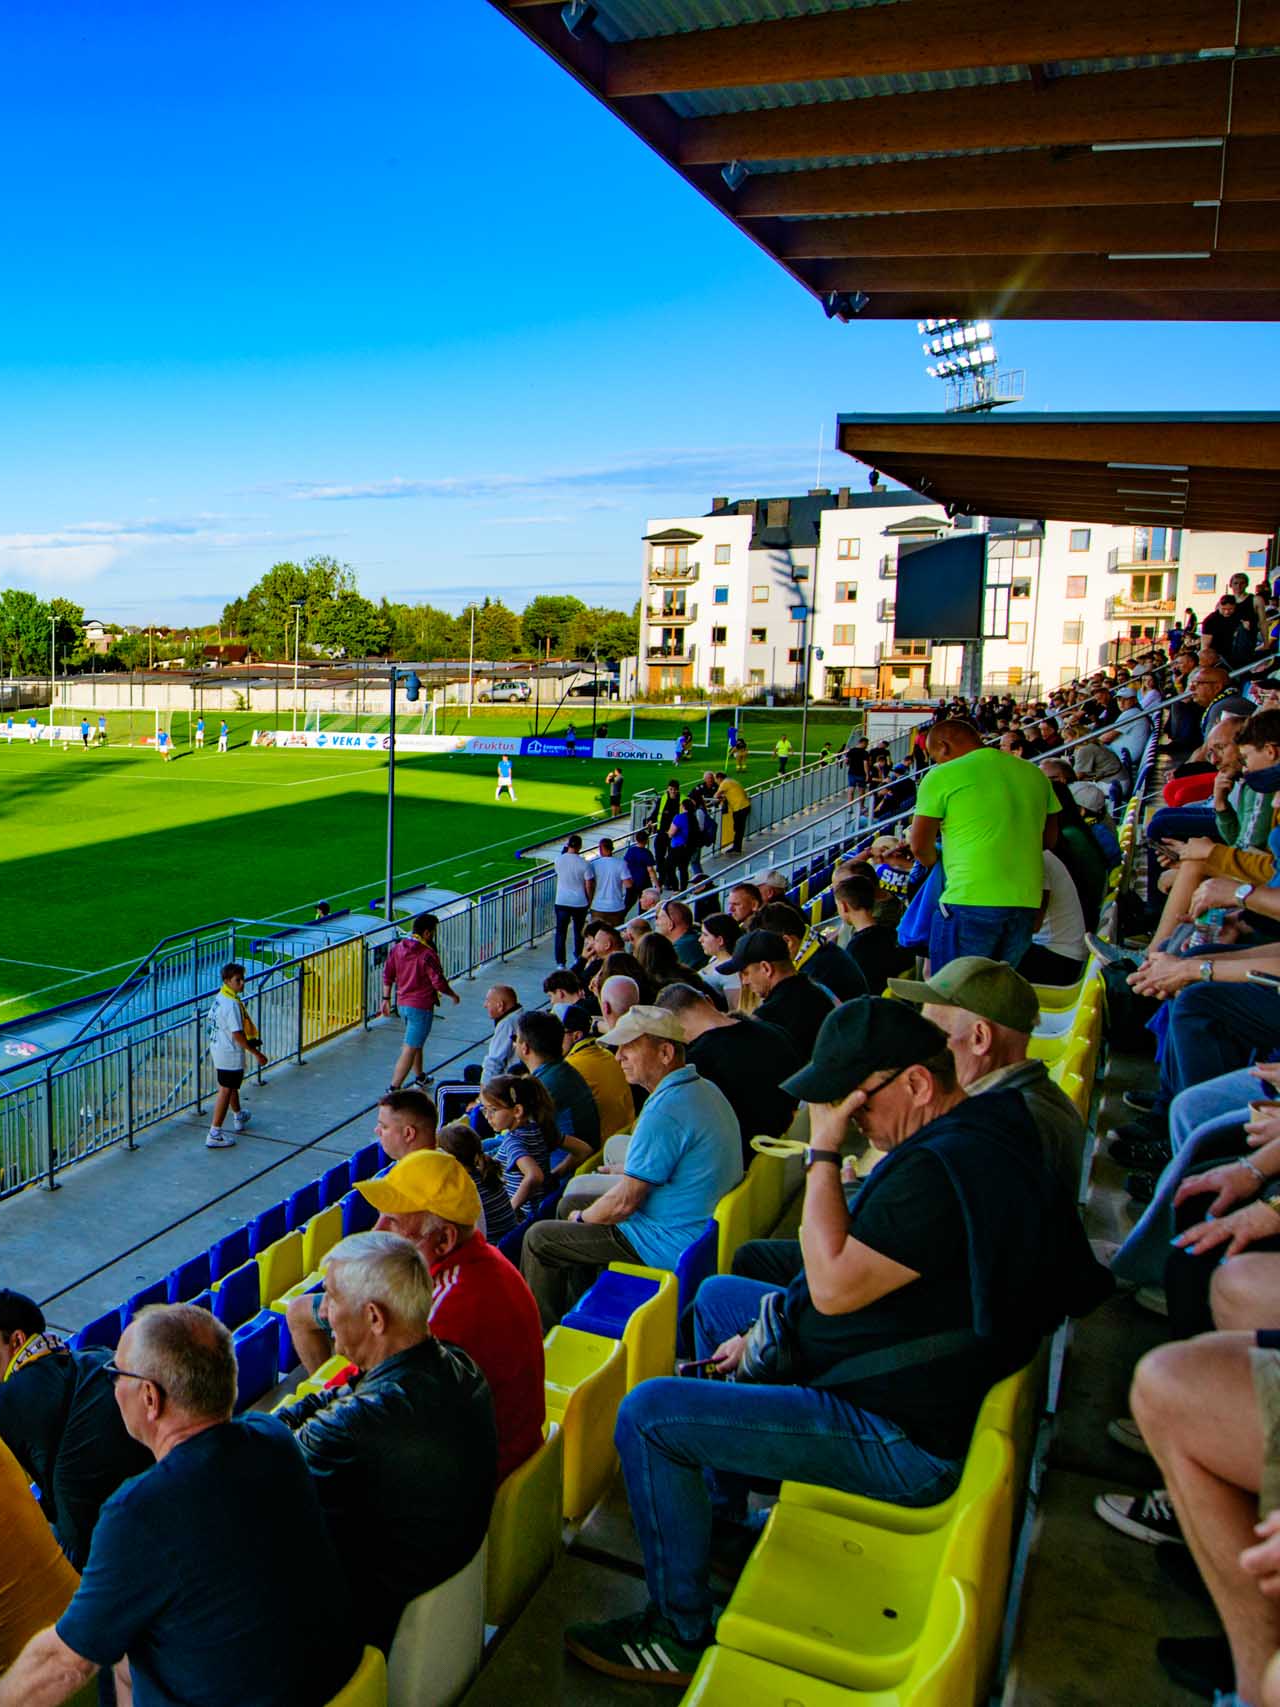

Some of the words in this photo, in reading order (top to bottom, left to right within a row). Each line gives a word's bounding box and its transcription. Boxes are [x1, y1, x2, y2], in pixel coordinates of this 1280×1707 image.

[332, 736, 361, 746] VEKA
[472, 740, 515, 751] Fruktus
[607, 751, 648, 759] BUDOKAN
[650, 752, 665, 760] L.D.
